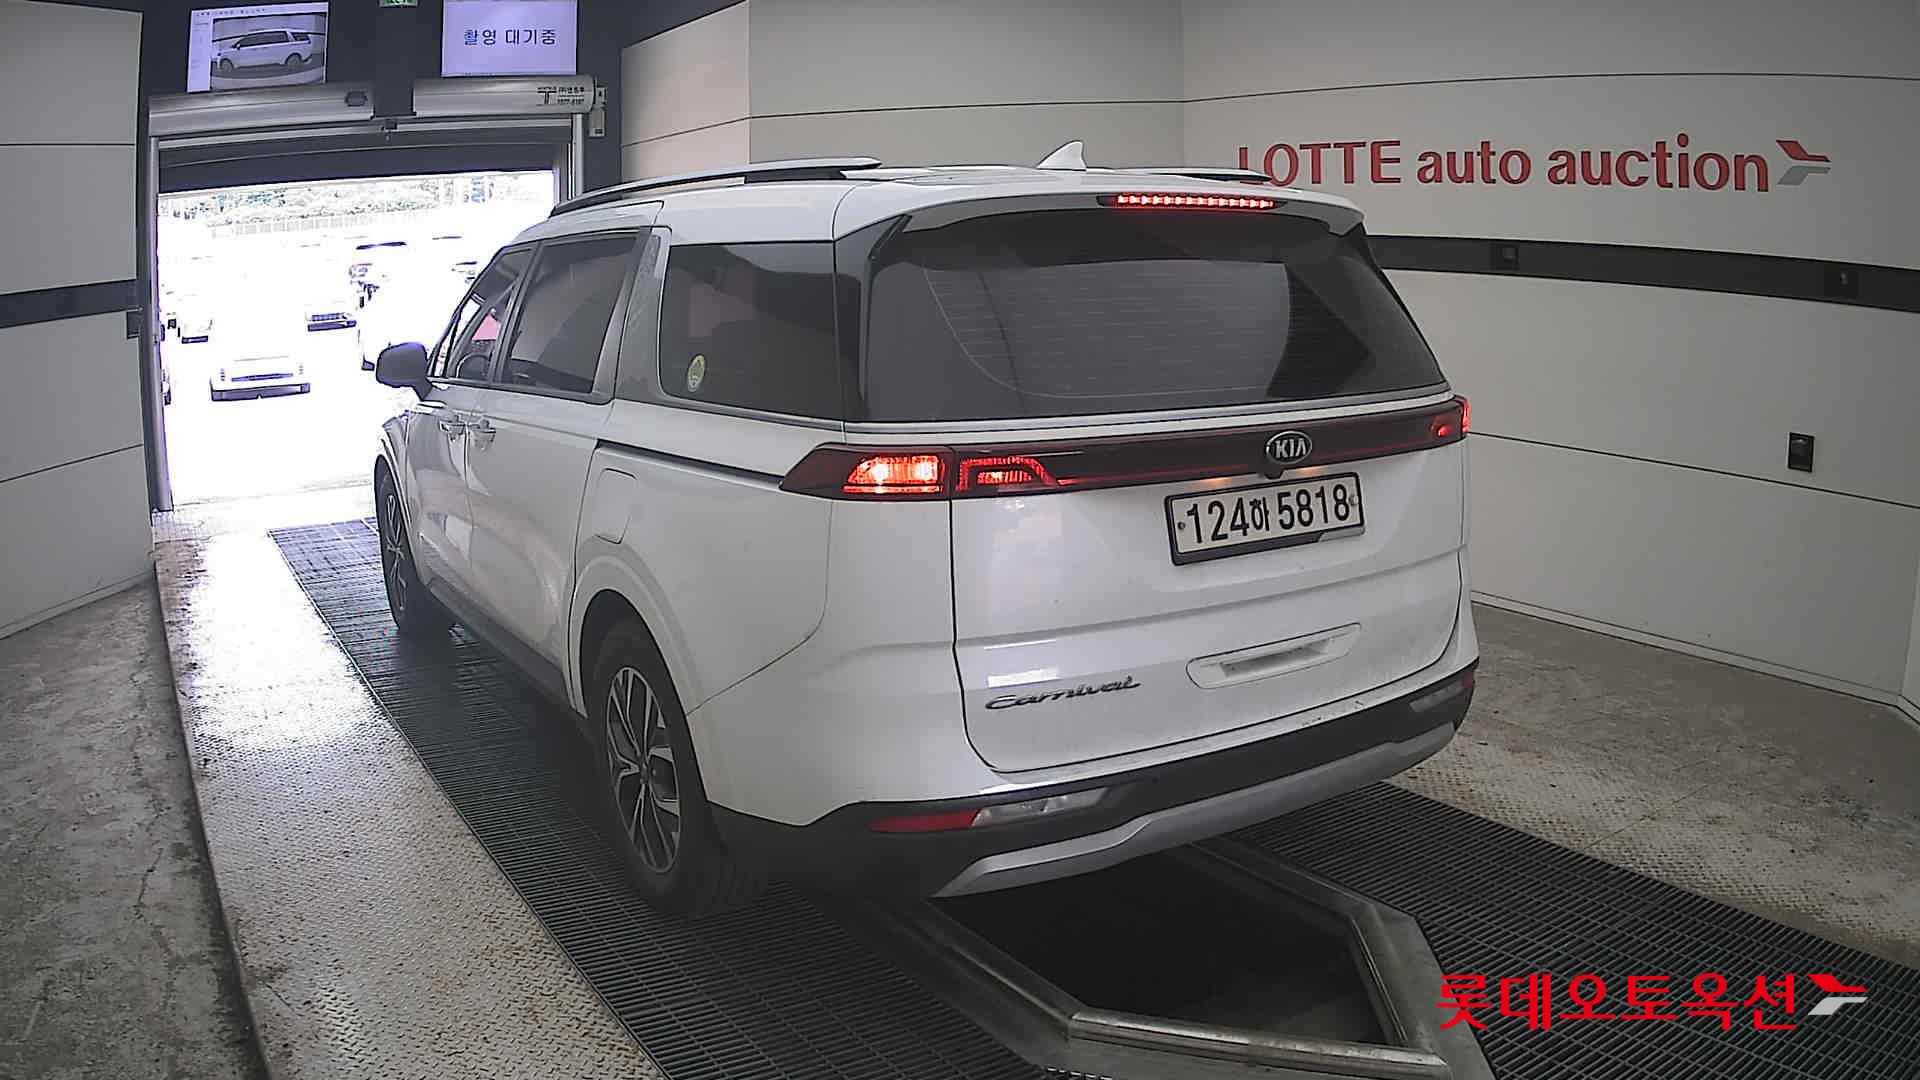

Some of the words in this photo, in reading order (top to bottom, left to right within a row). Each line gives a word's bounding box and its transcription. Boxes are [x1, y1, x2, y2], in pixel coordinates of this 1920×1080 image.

[464, 29, 496, 46] 촬영
[504, 29, 556, 46] 대기중
[1239, 141, 1401, 187] LOTTE
[1417, 141, 1532, 185] auto
[1547, 133, 1769, 192] auction
[1275, 437, 1306, 459] KIA
[1186, 496, 1270, 544] 124하
[1277, 484, 1351, 530] 5818
[985, 676, 1142, 710] Carnival
